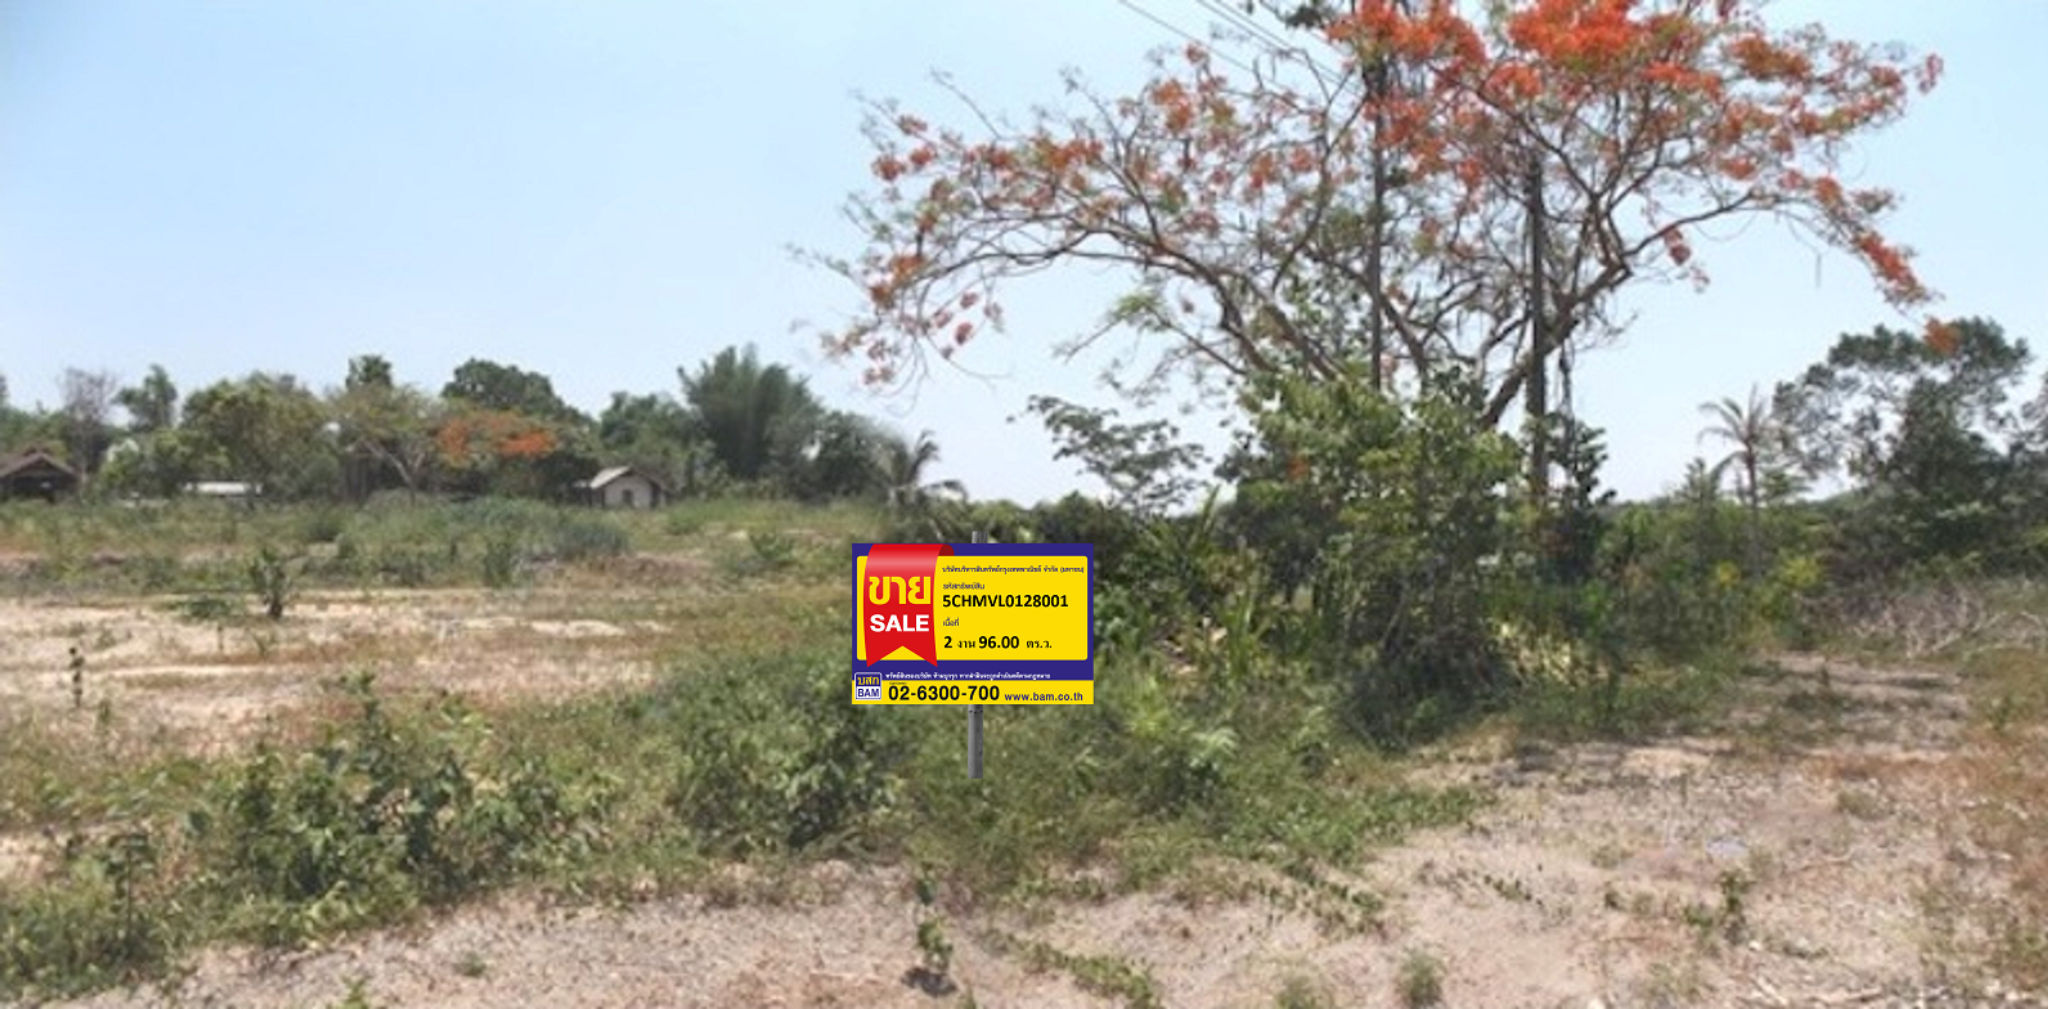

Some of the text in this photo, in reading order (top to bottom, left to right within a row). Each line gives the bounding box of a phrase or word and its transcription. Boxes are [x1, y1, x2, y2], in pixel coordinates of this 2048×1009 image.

[868, 576, 931, 605] ขาย
[943, 594, 1068, 607] 5CHMVL0128001
[870, 614, 929, 632] SALE
[943, 617, 959, 627] เนื้อที่
[944, 636, 1052, 649] 2 งาน 96.00 ตร.ว.
[857, 688, 880, 698] BAM
[888, 685, 1083, 701] 02-6300-700 www.bam.co.th
